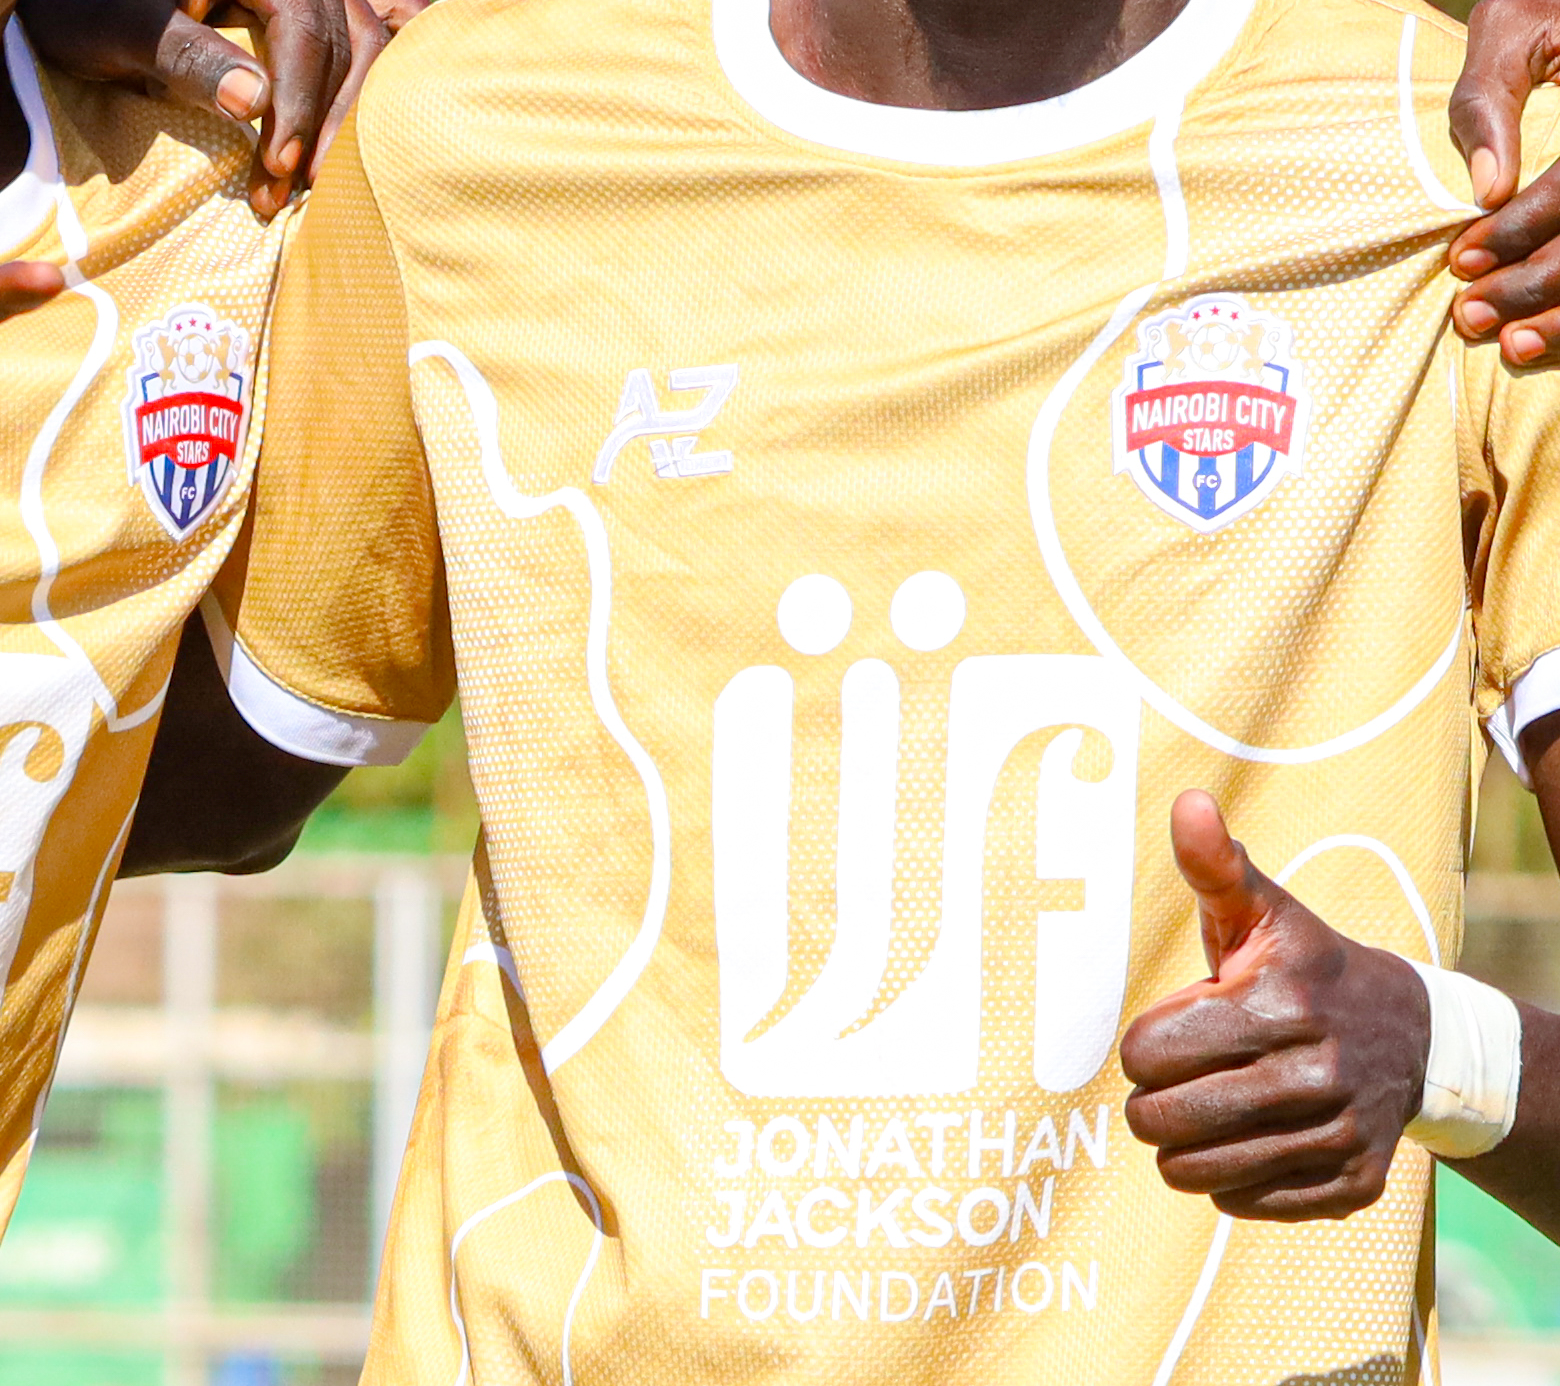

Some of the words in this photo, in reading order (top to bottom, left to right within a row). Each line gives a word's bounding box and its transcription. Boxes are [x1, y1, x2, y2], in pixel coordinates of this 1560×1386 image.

[141, 403, 206, 445] NAIROBI
[209, 405, 239, 444] CITY
[1132, 392, 1229, 433] NAIROBI
[1235, 394, 1287, 434] CITY
[176, 440, 211, 464] STARS
[1182, 428, 1235, 452] STARS
[181, 485, 196, 500] FC
[1196, 474, 1218, 488] FC
[713, 1102, 1110, 1179] JONATHAN
[704, 1175, 1056, 1251] JACKSON
[697, 1258, 1101, 1323] FOUNDATION
